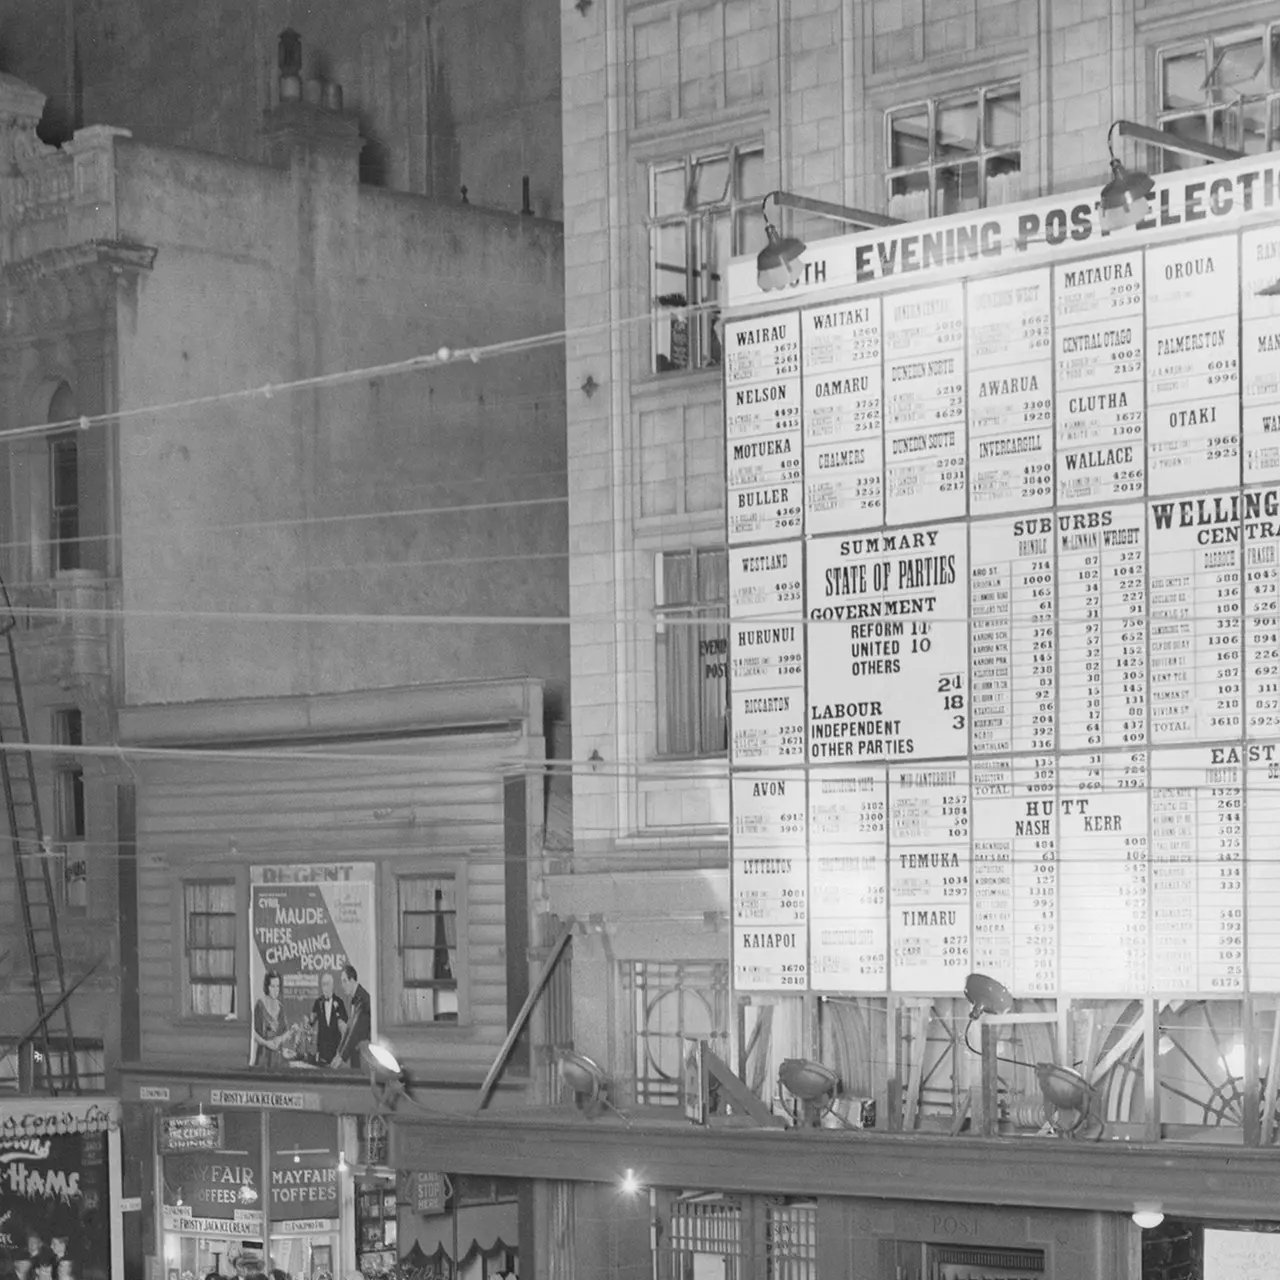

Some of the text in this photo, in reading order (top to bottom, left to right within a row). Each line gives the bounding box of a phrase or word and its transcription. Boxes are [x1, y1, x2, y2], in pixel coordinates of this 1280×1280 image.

[856, 221, 1001, 283] EVENING
[1018, 200, 1110, 252] POS
[1064, 262, 1133, 287] MATAURA
[1165, 257, 1214, 280] OROUA
[813, 307, 869, 329] WAITAKI
[737, 325, 786, 347] WAIRAU
[1157, 329, 1225, 356] PALMERSTON
[736, 384, 786, 405] NELSON
[815, 376, 868, 398] OAMARU
[979, 375, 1039, 398] AWARUA
[1069, 392, 1128, 413] CLUTHA
[1170, 406, 1216, 428] OTAKI
[734, 438, 792, 460] MOTUEKA
[819, 449, 865, 469] CHALMERS
[1065, 446, 1133, 470] WALLACE
[738, 488, 789, 508] BULLER
[826, 554, 956, 597] STATE OF PARTIES
[851, 623, 903, 638] REFORM
[851, 638, 931, 658] UNITED 10
[812, 696, 964, 720] LABOUR 18
[812, 740, 914, 759] OTHER PARTIES
[1211, 745, 1275, 765] EAST
[753, 781, 785, 797] AVON
[1015, 815, 1122, 836] NASH KERR
[262, 866, 353, 883] REGENT
[266, 933, 331, 964] CHARMING
[743, 933, 796, 948] KAIAPOI
[220, 1091, 242, 1103] FROSTY
[272, 1169, 336, 1184] MAYFAIR
[272, 1187, 336, 1202] TOFFEES
[419, 1183, 440, 1198] STOP
[181, 1219, 202, 1229] FROSTY
